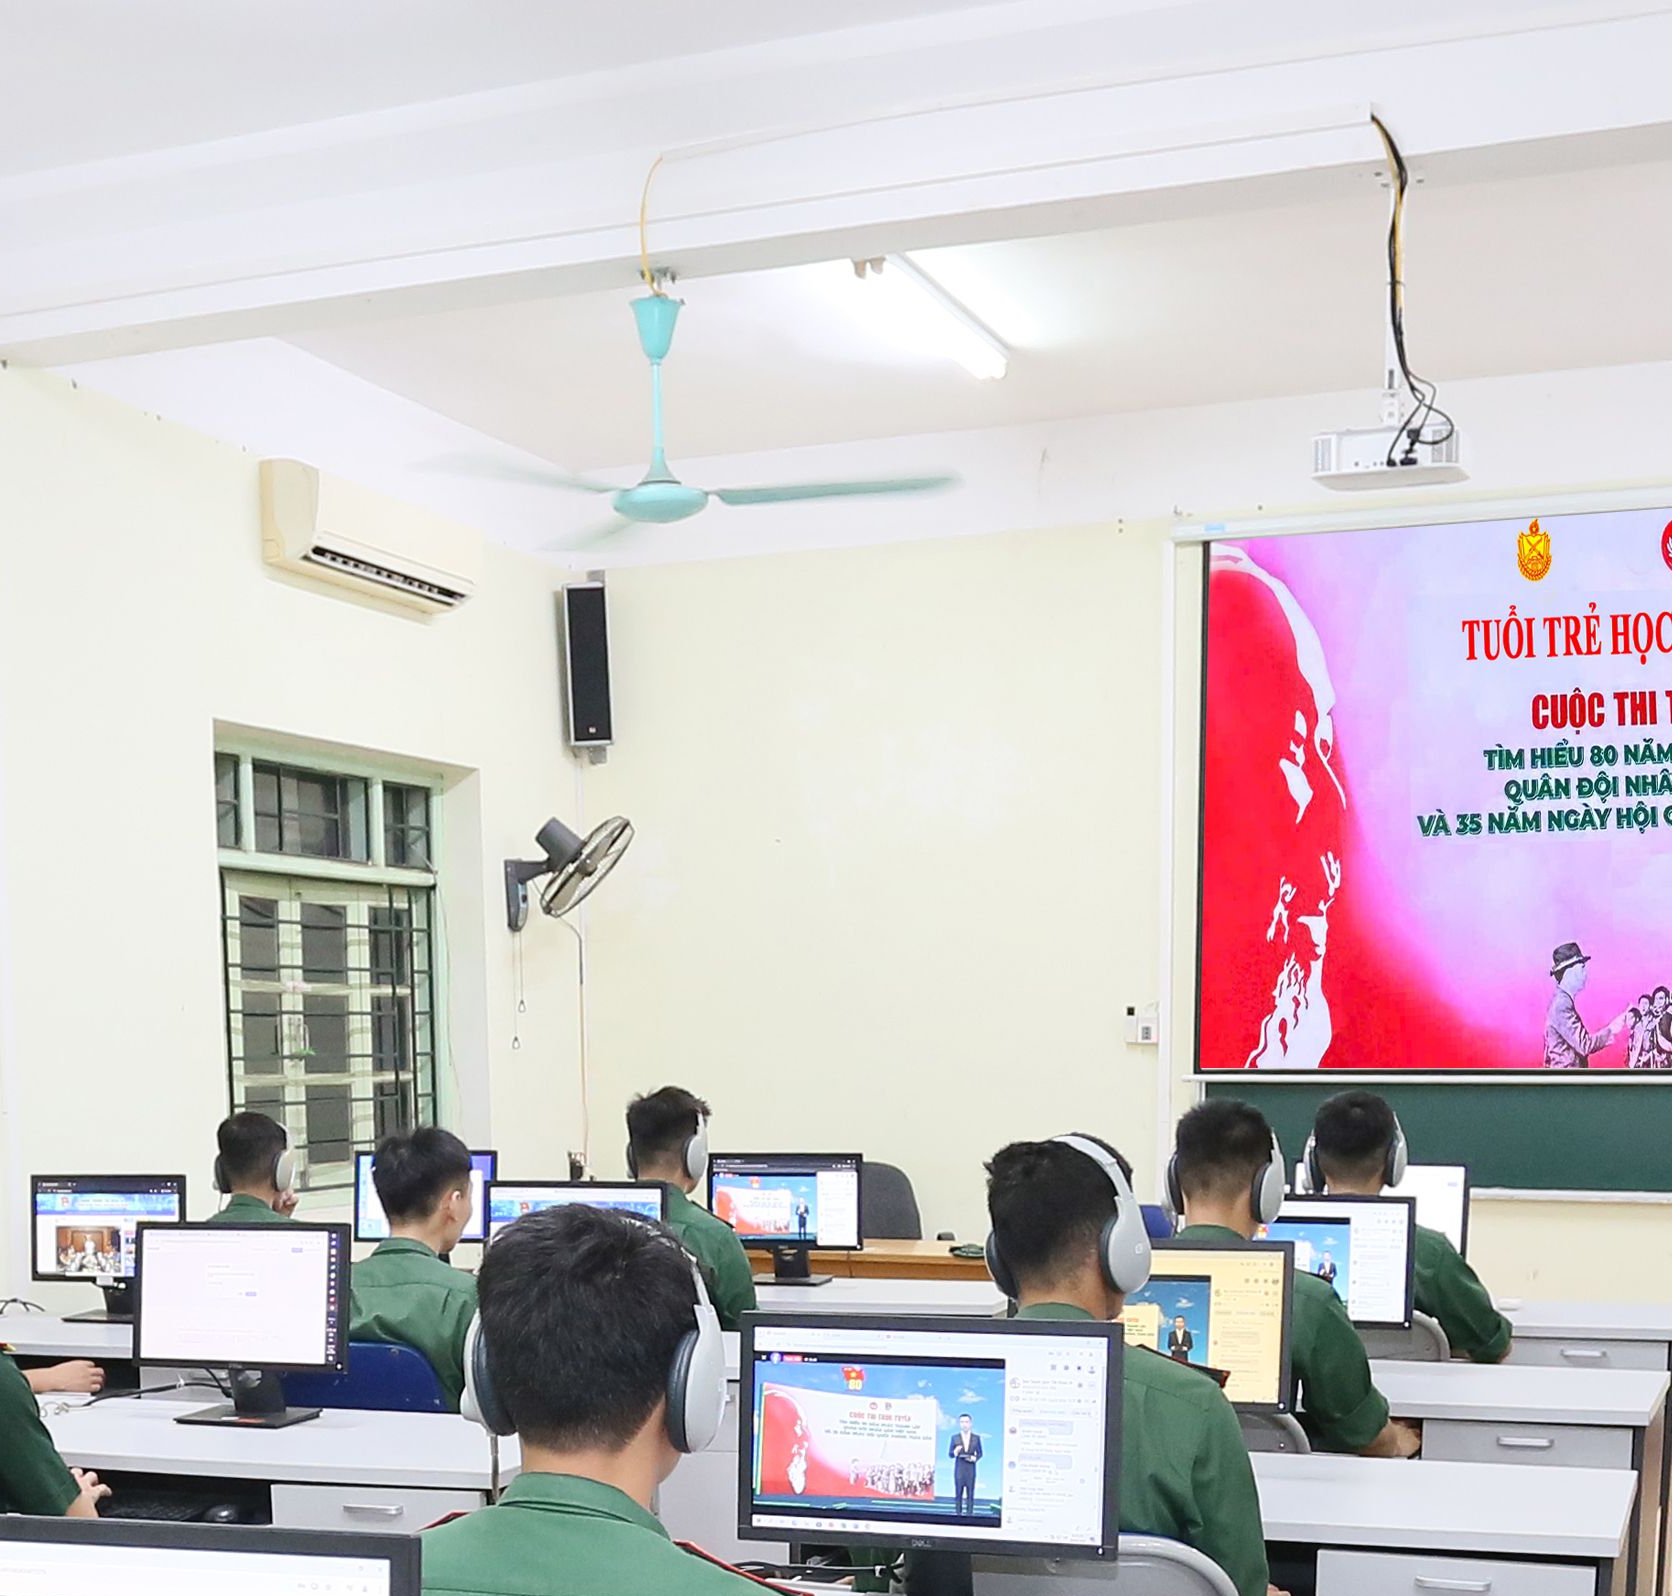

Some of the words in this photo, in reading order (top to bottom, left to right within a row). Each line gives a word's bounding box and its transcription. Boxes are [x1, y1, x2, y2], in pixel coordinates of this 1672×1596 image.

[1462, 605, 1535, 660] TUỔI
[1543, 602, 1602, 657] TRẺ
[1531, 687, 1605, 735] CUỘC
[1613, 691, 1657, 726] THI
[1484, 743, 1527, 770] TÌM
[1530, 739, 1585, 769] HIỂU
[1590, 746, 1618, 767] 80
[1504, 774, 1570, 805] QUÂN
[1576, 771, 1618, 802] ĐỘI
[1417, 809, 1451, 837] VÀ
[1455, 813, 1482, 834] 35
[1488, 806, 1542, 833] NĂM
[1547, 805, 1612, 830] NGÀY
[1616, 801, 1658, 832] HỘI
